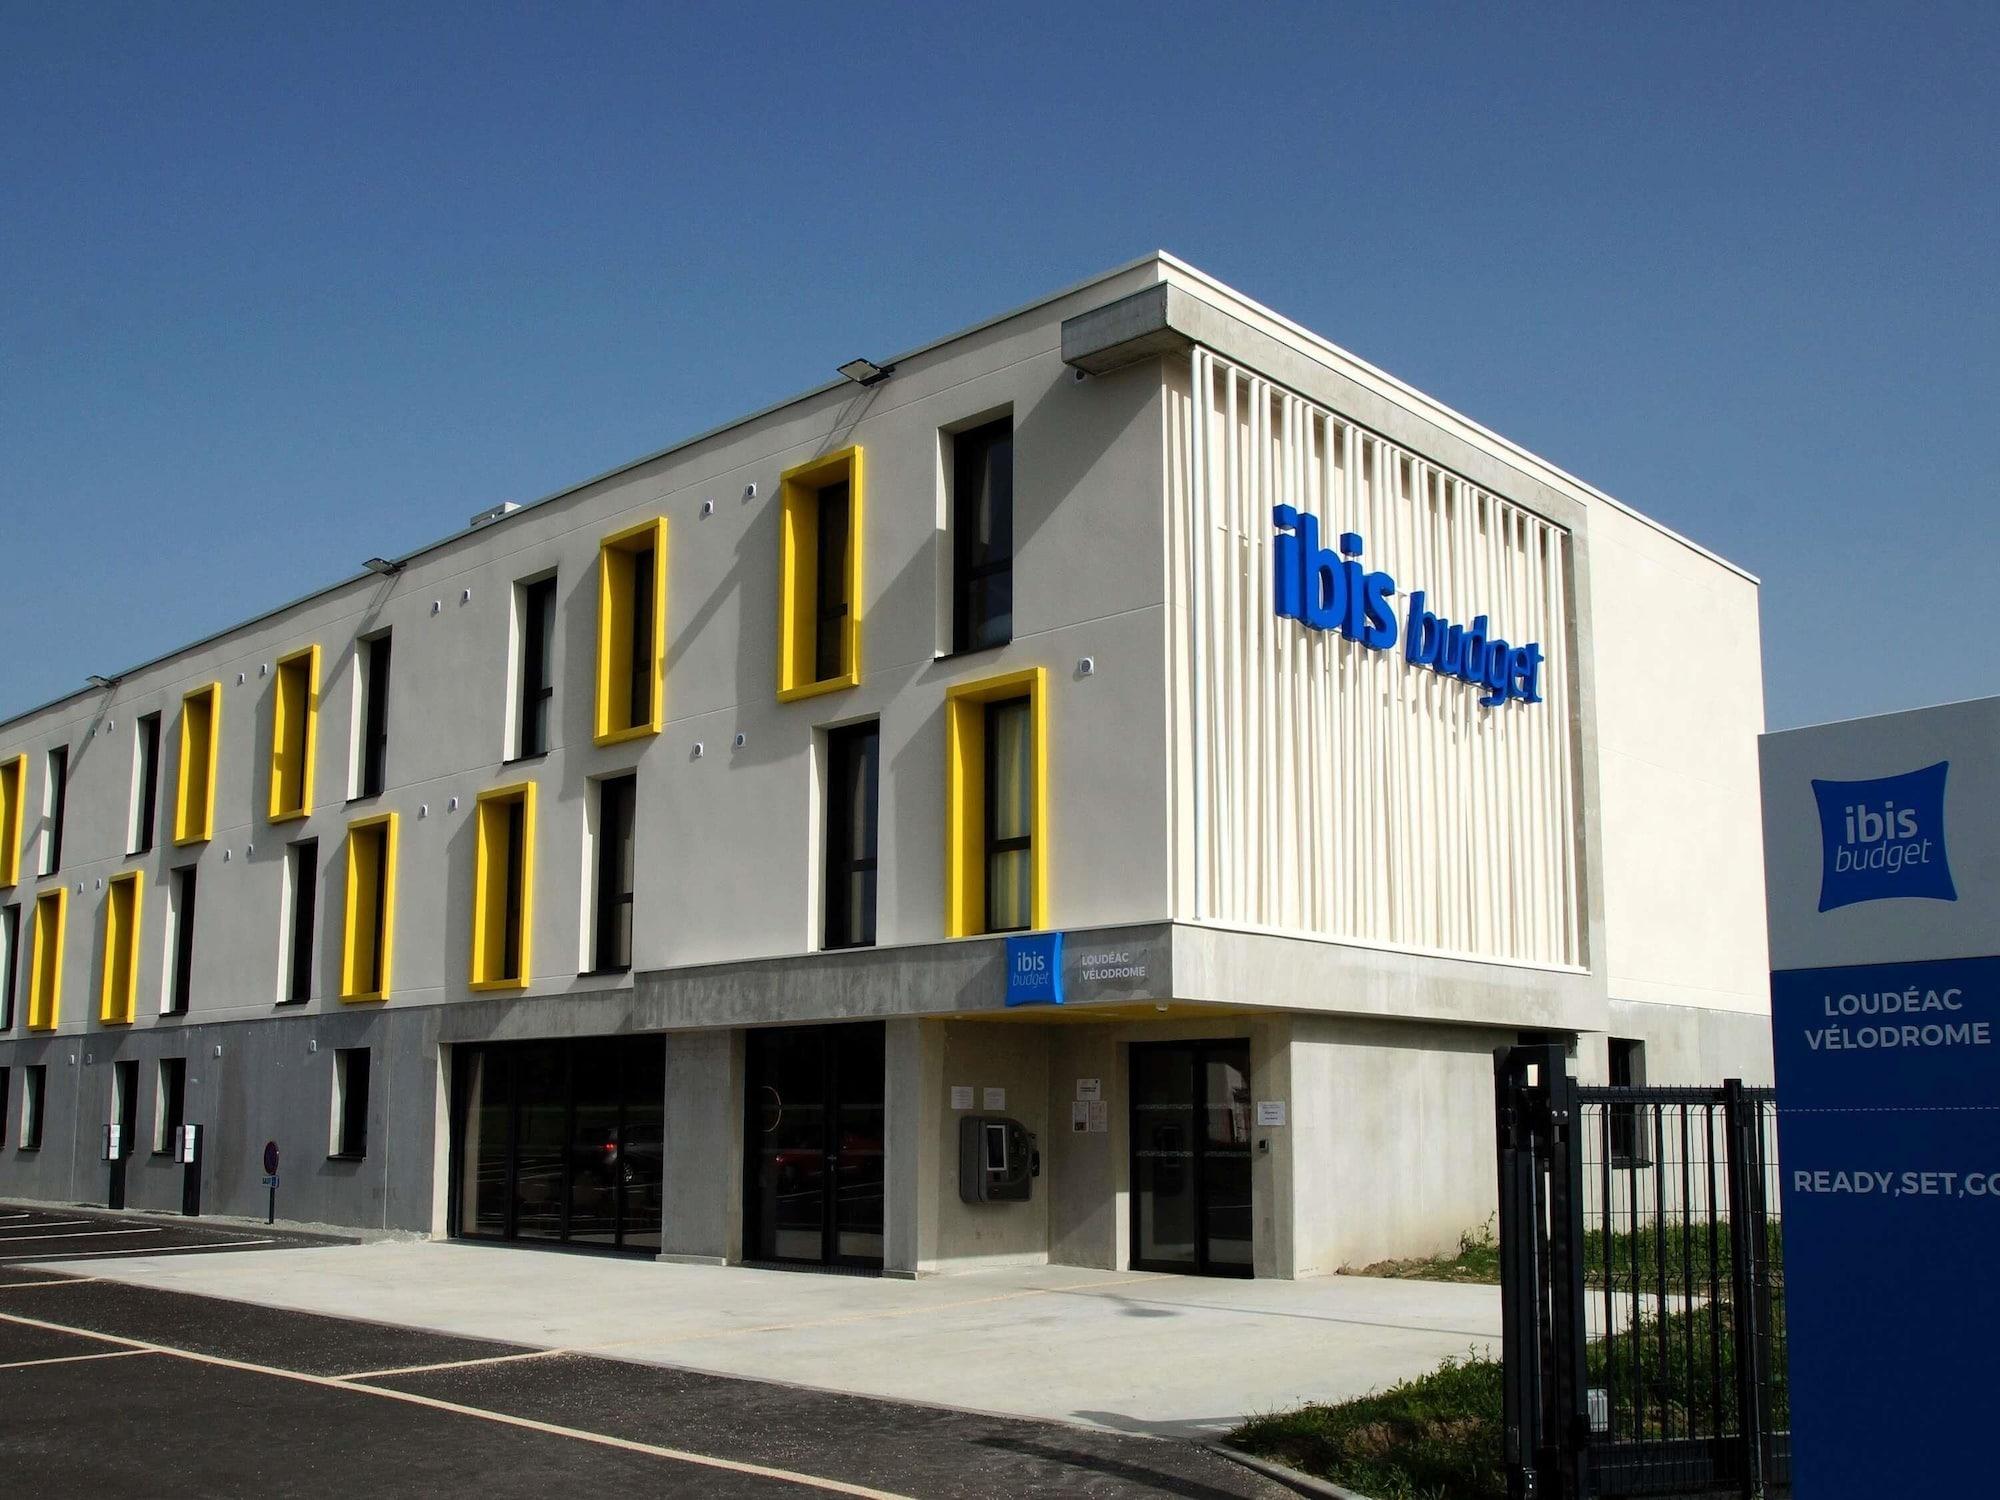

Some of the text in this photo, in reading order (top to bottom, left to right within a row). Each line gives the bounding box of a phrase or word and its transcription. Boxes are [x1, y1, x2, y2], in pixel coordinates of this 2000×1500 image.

[1273, 503, 1544, 707] ibis budget
[1845, 801, 1918, 844] ibis
[1835, 838, 1932, 873] budget
[1017, 951, 1045, 972] ibis
[1081, 952, 1129, 966] LOUDÉAC
[1082, 966, 1146, 980] VÉLODROME
[1012, 971, 1049, 988] budget
[1824, 985, 1963, 1016] LOUDÉAC
[1805, 1022, 1991, 1050] VÉLODROME
